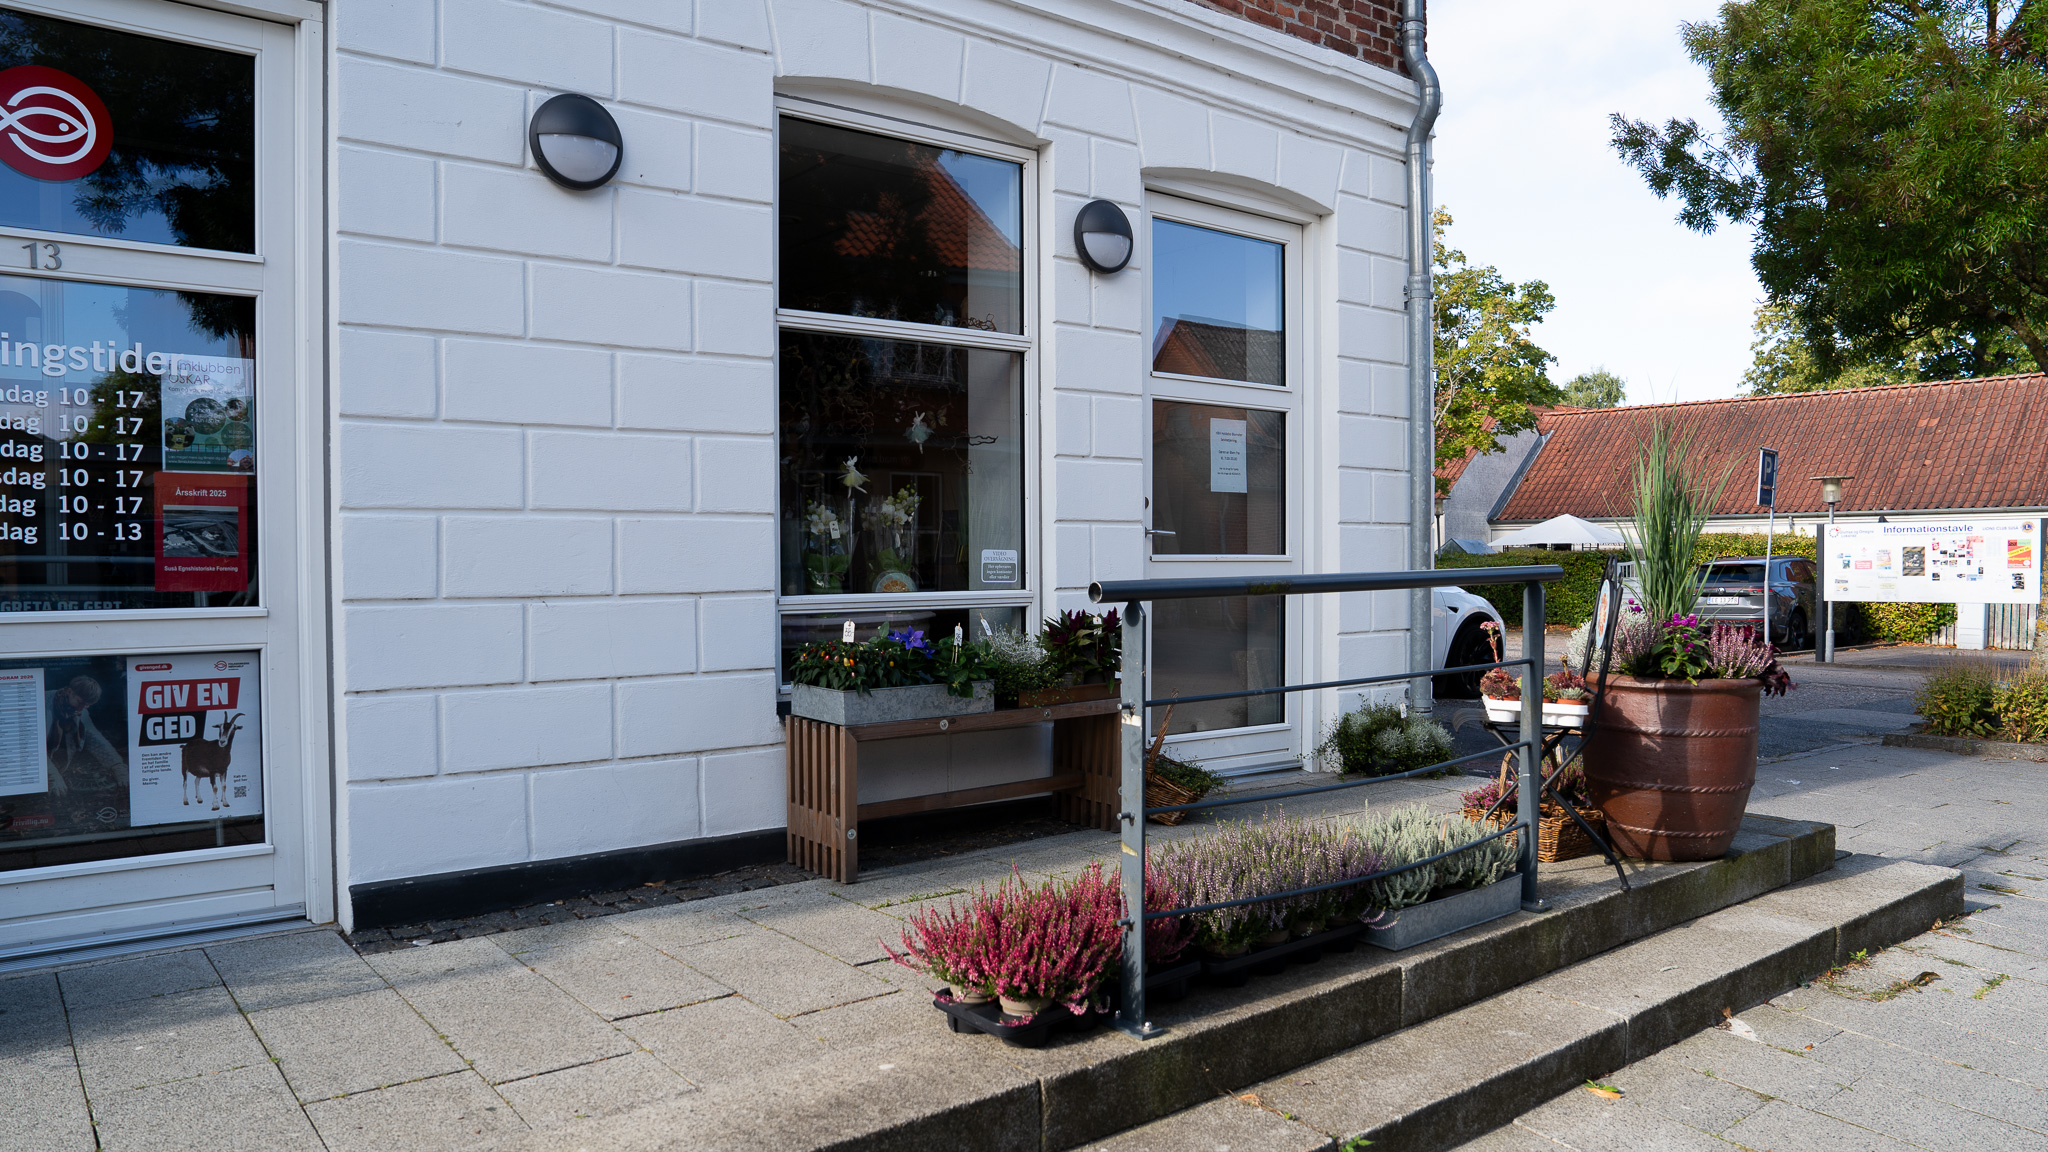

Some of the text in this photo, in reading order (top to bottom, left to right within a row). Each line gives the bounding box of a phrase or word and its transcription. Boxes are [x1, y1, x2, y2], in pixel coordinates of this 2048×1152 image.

[21, 241, 62, 270] 13
[1, 332, 188, 377] ingstider.
[168, 372, 211, 385] OSKAR
[59, 387, 89, 406] 10
[115, 390, 144, 409] 17
[59, 414, 89, 432] 10
[115, 417, 143, 435] 17
[0, 439, 44, 462] dag
[60, 441, 89, 460] 10
[116, 443, 144, 461] 17
[59, 468, 89, 487] 10
[115, 470, 143, 488] 17
[1764, 456, 1772, 481] P
[176, 487, 208, 496] Årsskrift
[59, 495, 88, 513] 10
[115, 496, 143, 514] 17
[59, 522, 88, 540] 10
[114, 523, 142, 540] 13
[1883, 524, 1973, 534] Informationstavle
[145, 682, 228, 709] GIV EN
[146, 715, 196, 740] GED
